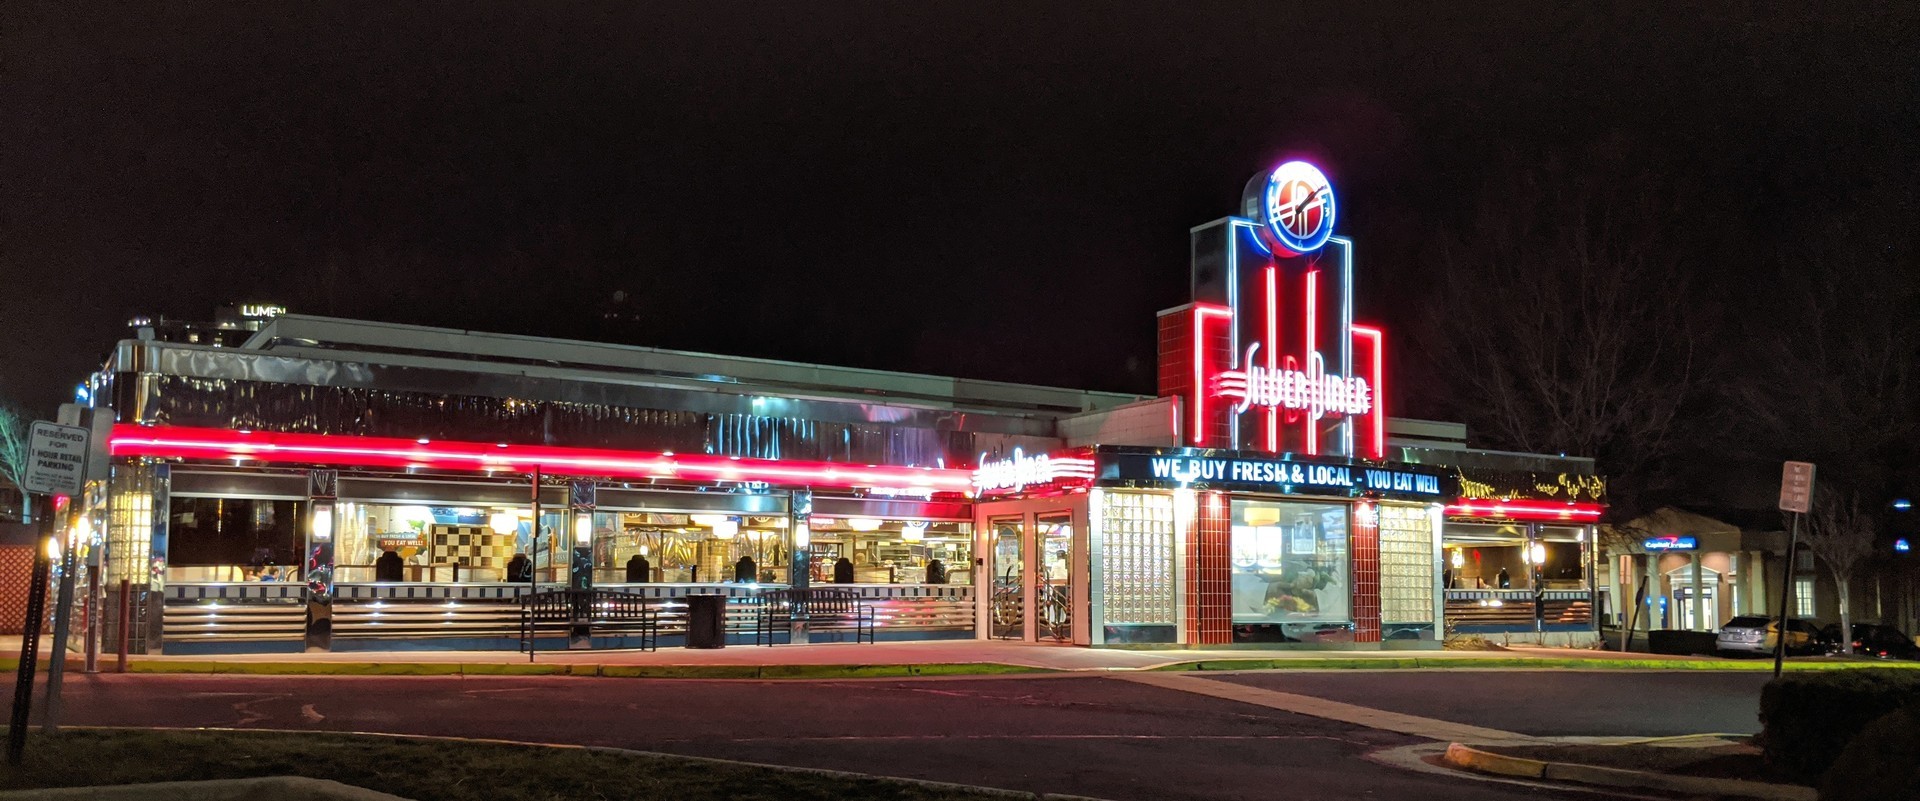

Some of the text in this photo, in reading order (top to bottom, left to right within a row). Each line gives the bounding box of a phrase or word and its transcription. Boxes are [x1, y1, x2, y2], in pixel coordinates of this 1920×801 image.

[37, 429, 83, 442] RESERVED
[49, 441, 68, 449] FOR
[38, 450, 58, 459] HOUR
[60, 453, 82, 463] RETAIL
[38, 460, 74, 471] PARKING
[1152, 458, 1182, 479] WE
[1189, 459, 1226, 480] BUY
[1232, 461, 1287, 482] FRESH
[1291, 464, 1304, 483] &
[1308, 465, 1353, 486] LOCAL
[1366, 469, 1391, 489] YOU
[1394, 472, 1413, 491] EAT
[1415, 474, 1439, 494] WELL
